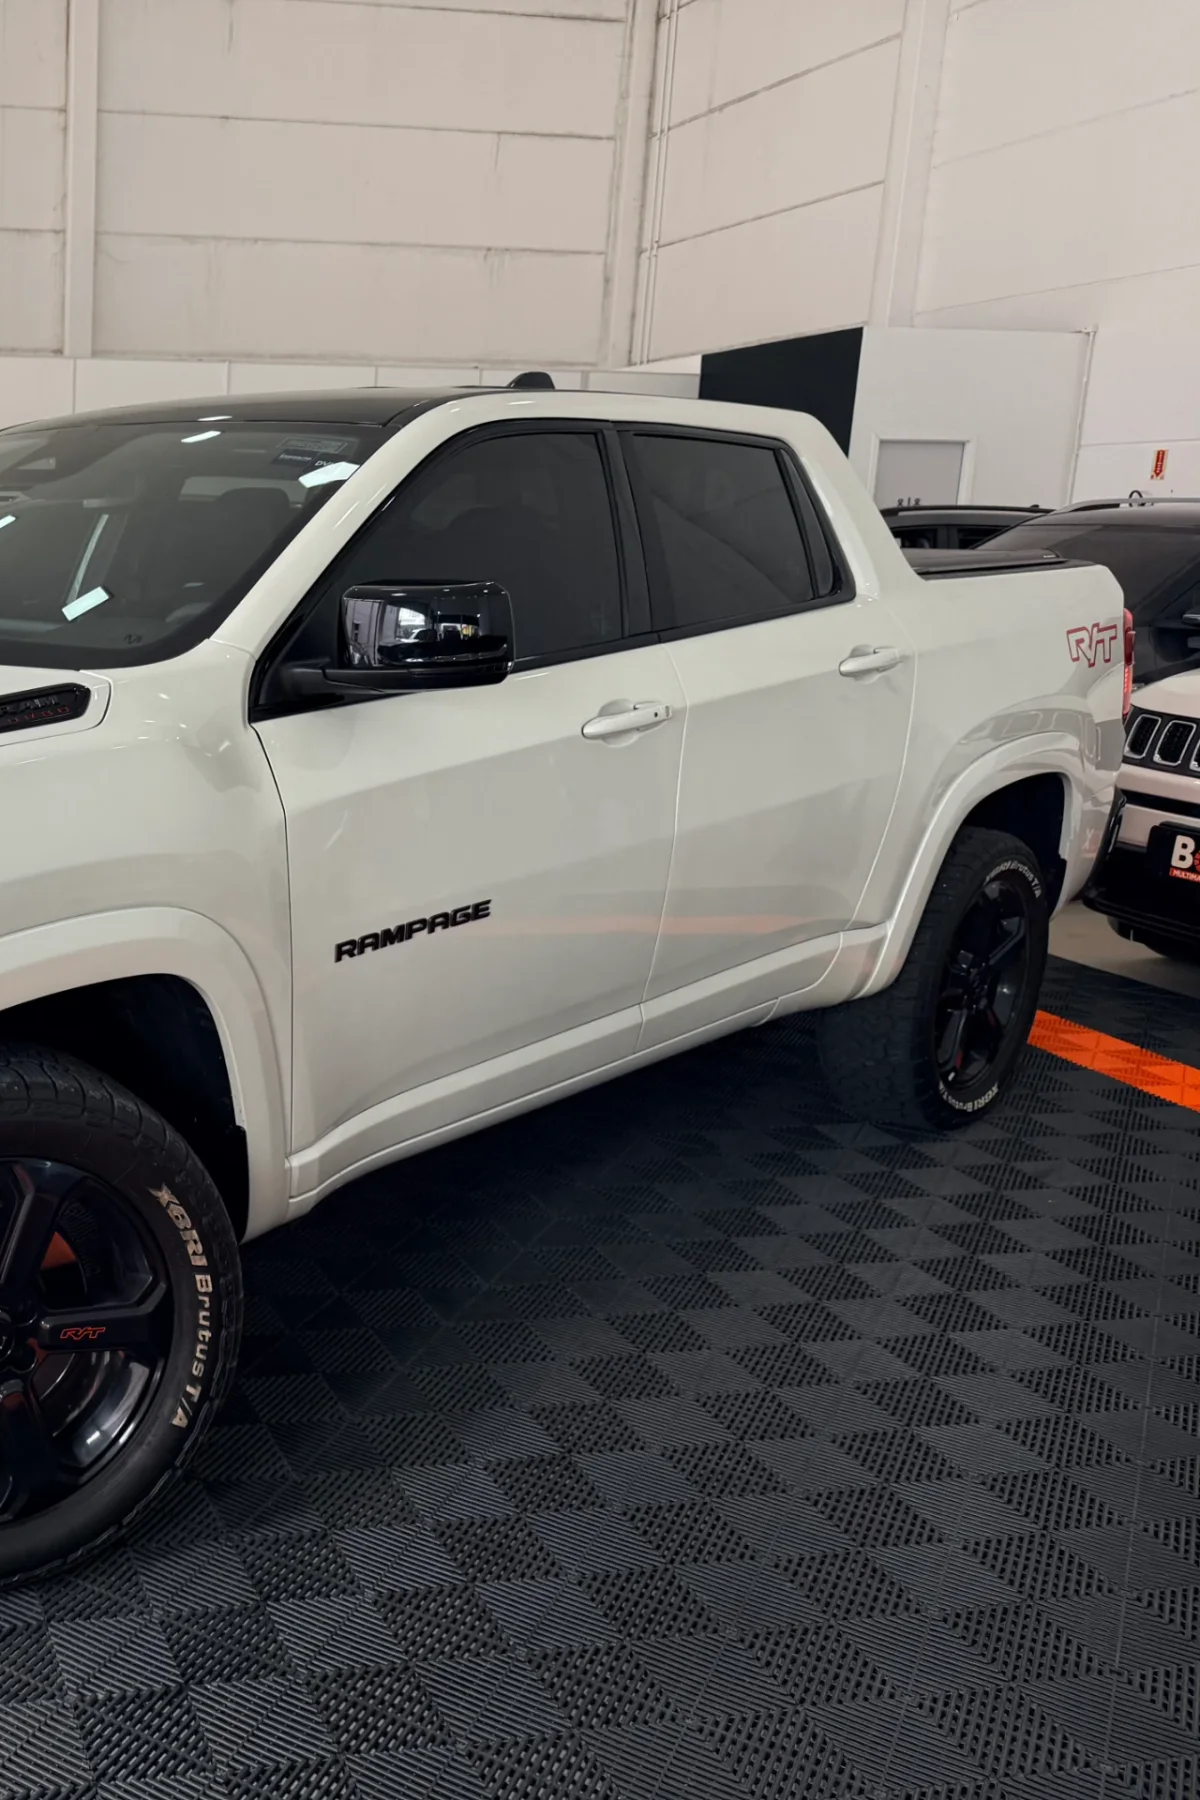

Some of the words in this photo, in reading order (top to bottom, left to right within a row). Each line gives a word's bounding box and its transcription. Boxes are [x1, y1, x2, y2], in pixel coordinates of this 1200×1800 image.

[1066, 622, 1118, 668] R/T
[334, 899, 492, 963] RAMPAGE
[60, 1327, 106, 1341] R/T
[192, 1274, 213, 1378] Brutus
[170, 1384, 202, 1428] T/A
